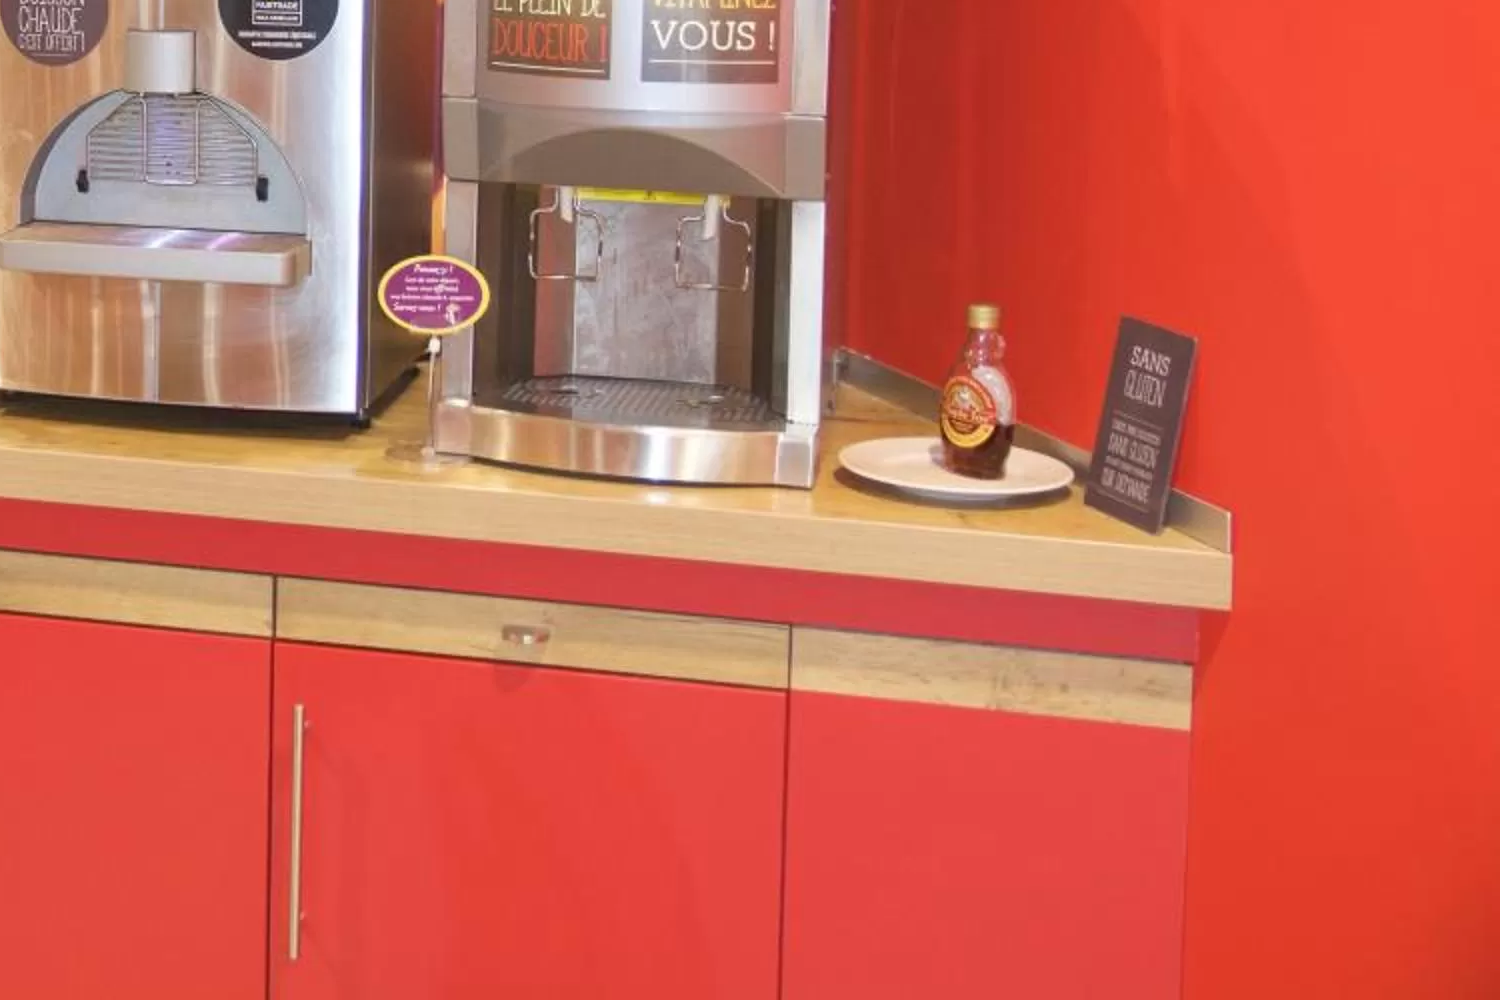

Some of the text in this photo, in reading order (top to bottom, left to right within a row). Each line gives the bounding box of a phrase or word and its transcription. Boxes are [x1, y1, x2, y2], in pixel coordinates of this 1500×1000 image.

[18, 5, 85, 35] CHAUDE
[651, 20, 776, 52] VOUS !
[491, 18, 590, 63] DOUCEUR
[1129, 344, 1172, 377] SANS
[1123, 368, 1167, 409] GLUTEN
